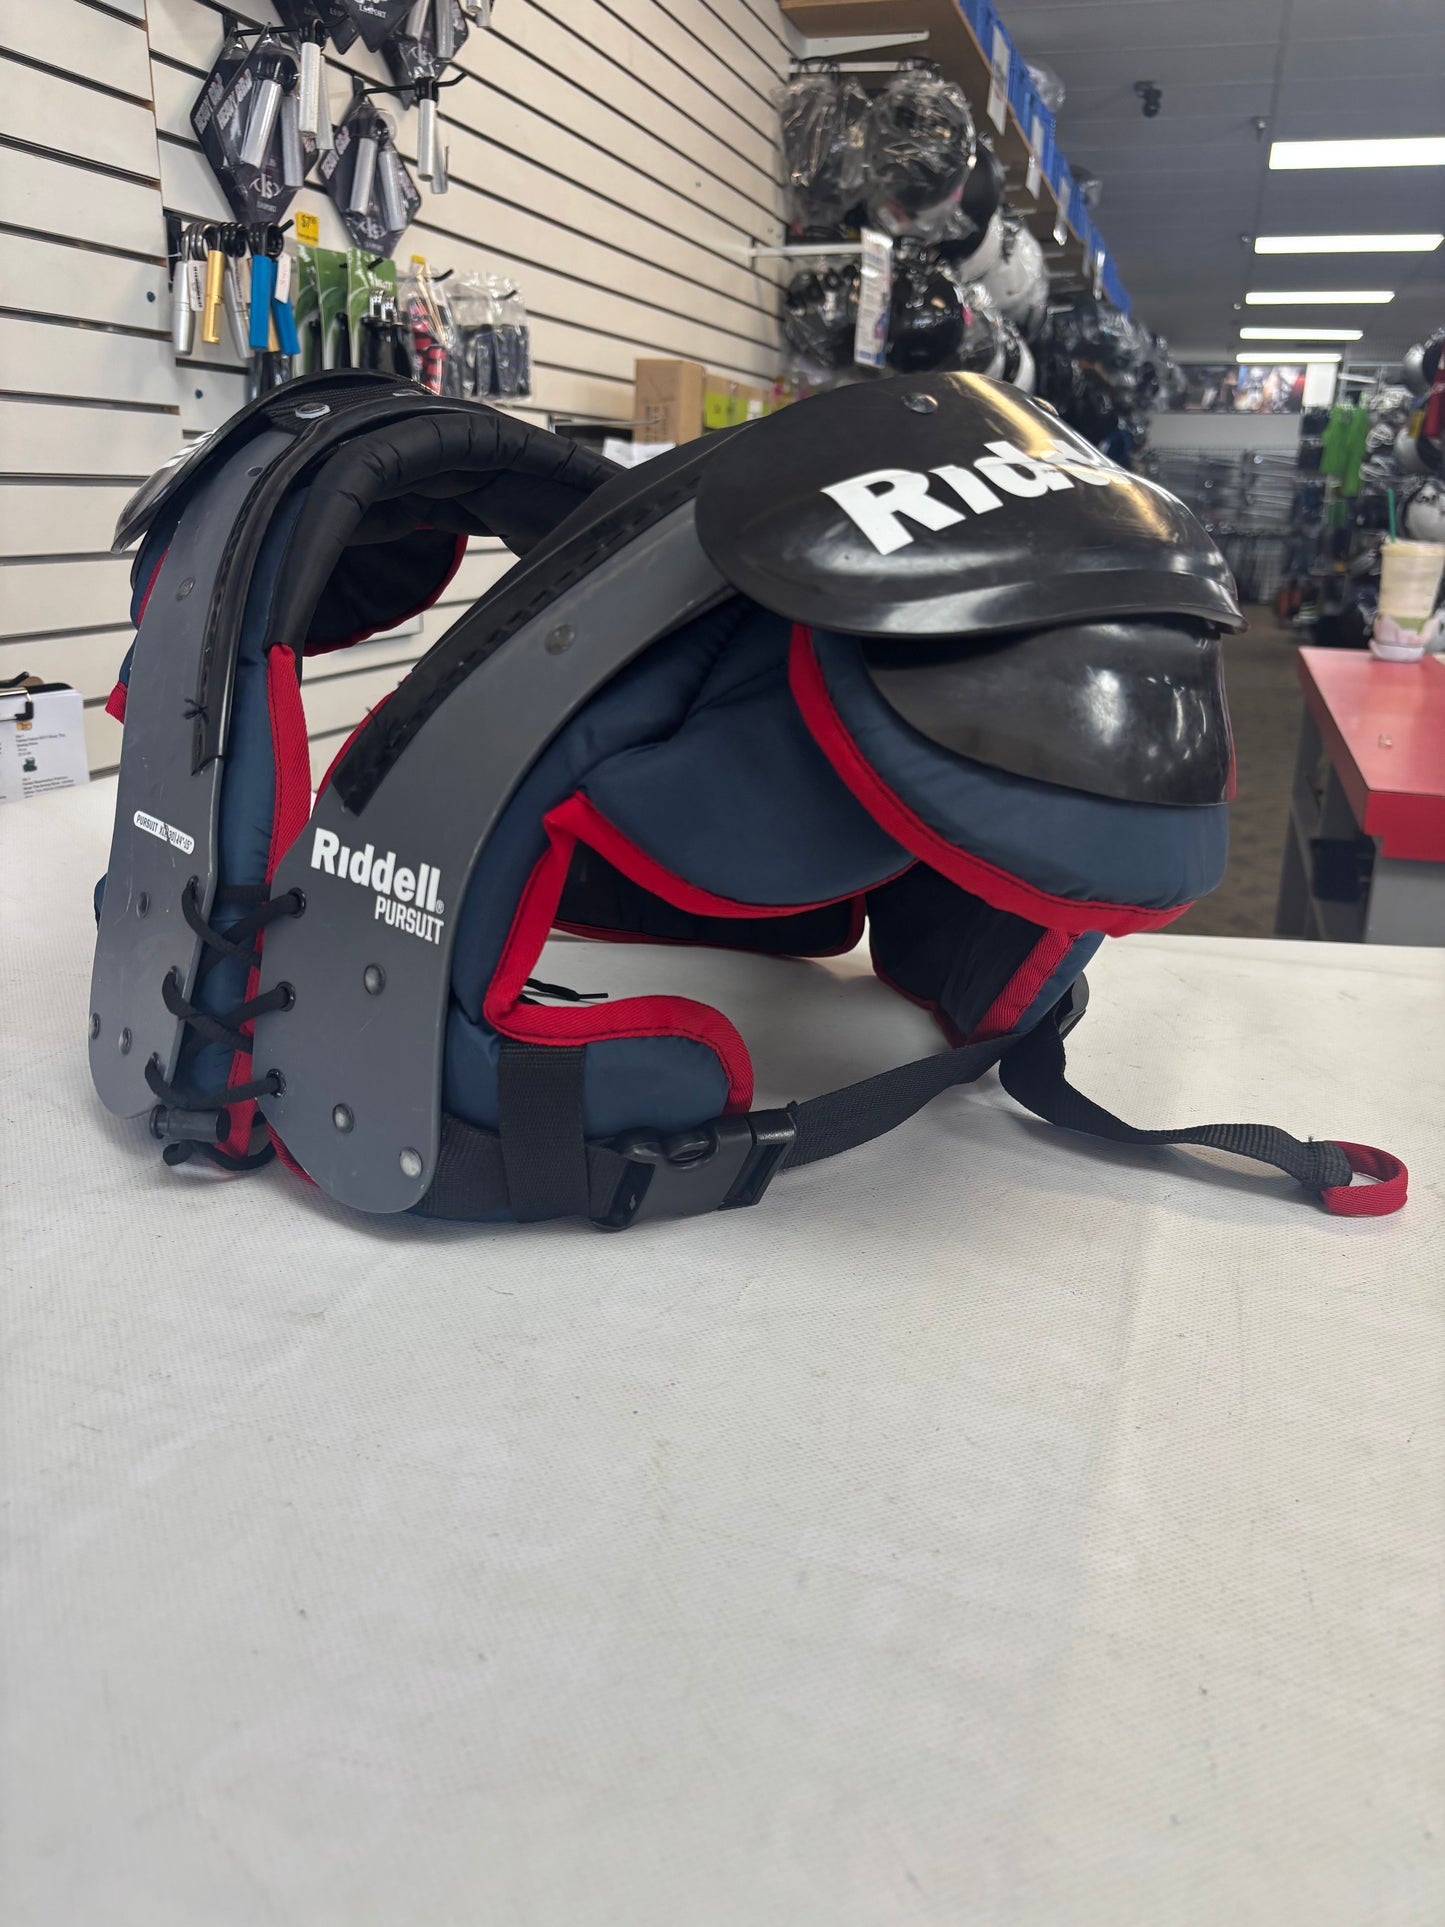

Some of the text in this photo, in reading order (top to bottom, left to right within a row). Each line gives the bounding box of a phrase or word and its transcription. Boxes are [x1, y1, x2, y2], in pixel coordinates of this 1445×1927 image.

[819, 439, 1112, 556] Ridd
[137, 814, 159, 833] PURSUIT
[374, 894, 444, 945] PURSUIT
